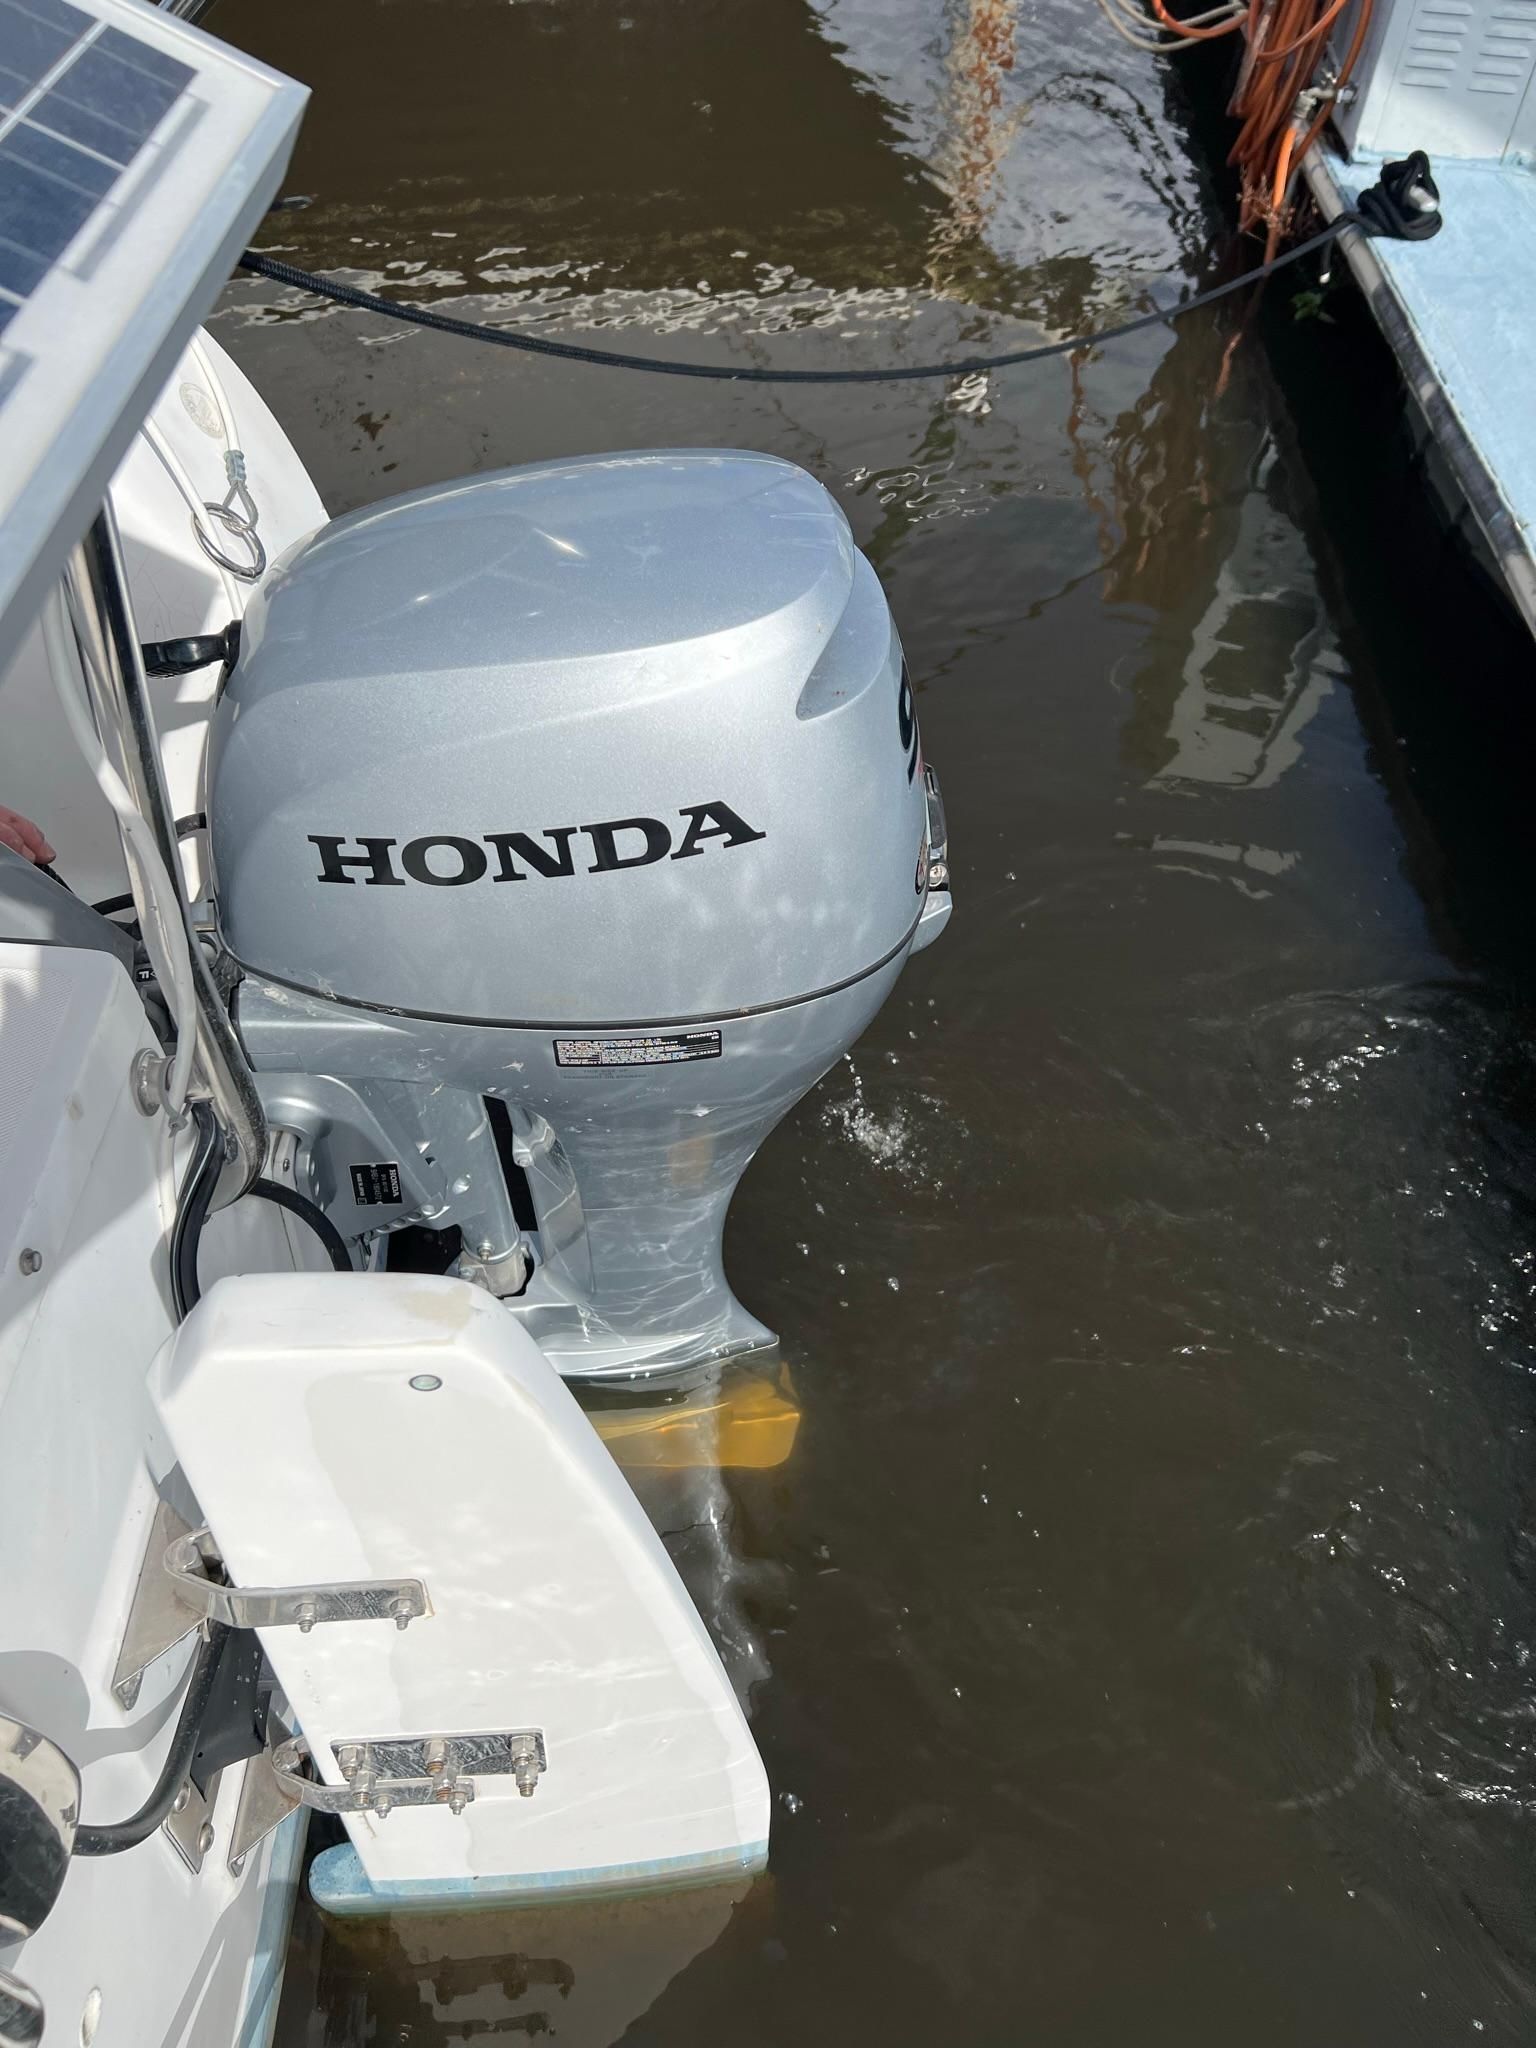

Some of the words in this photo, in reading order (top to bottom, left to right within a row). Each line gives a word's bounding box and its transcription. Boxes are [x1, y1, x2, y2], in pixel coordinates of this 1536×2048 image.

[307, 800, 767, 887] HONDA
[686, 1031, 719, 1039] HONDA
[389, 1169, 399, 1197] HONDA
